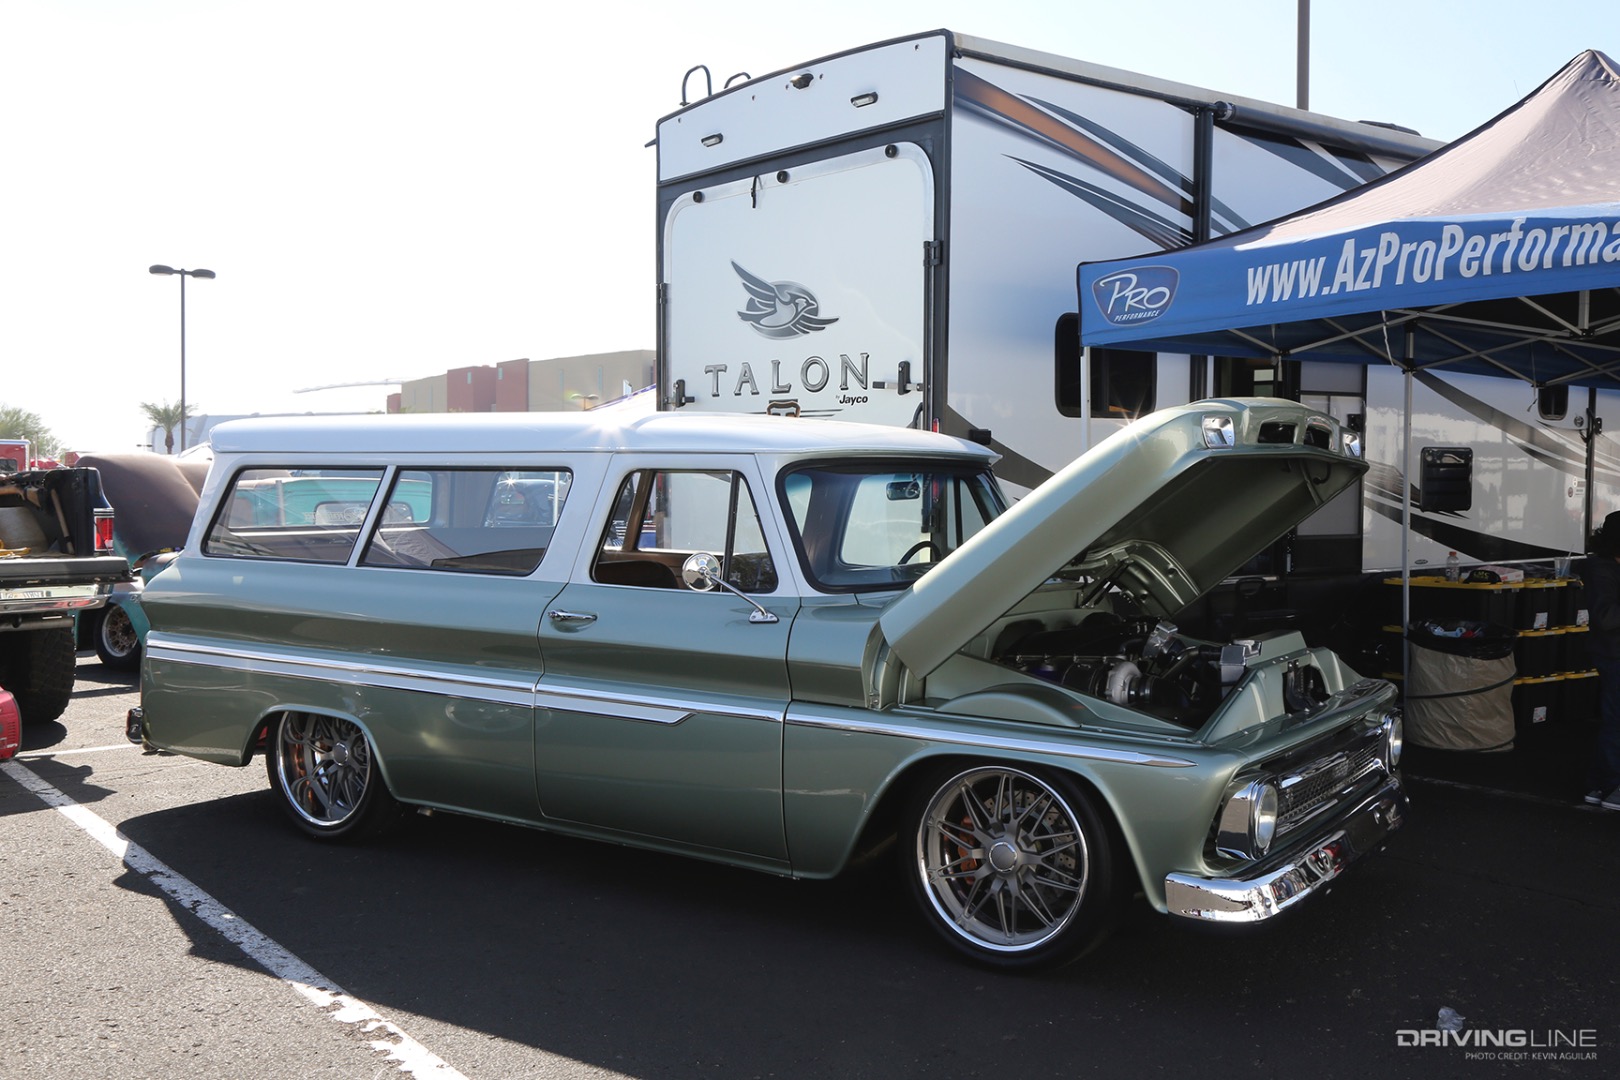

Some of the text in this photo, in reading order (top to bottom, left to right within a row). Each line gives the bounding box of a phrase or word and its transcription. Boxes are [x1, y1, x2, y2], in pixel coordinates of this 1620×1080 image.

[1113, 310, 1160, 322] PERFORMANCE
[704, 352, 870, 397] TALON
[839, 394, 869, 406] Jayco
